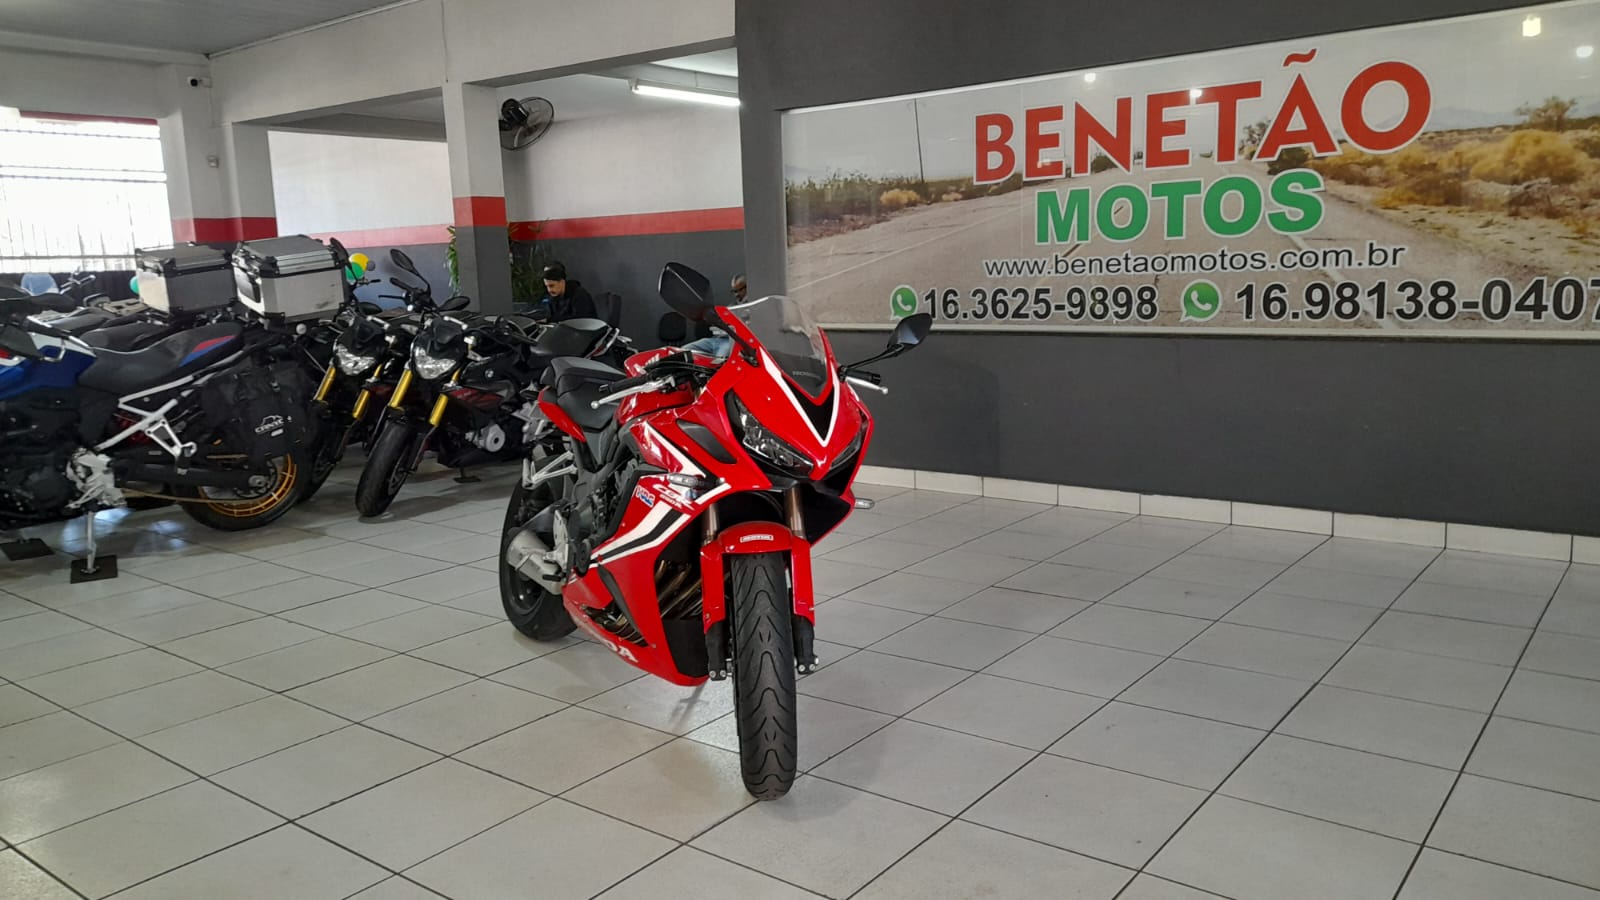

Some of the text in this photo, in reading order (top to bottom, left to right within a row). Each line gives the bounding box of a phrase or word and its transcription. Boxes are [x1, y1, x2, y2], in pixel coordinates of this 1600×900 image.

[975, 48, 1432, 183] BENETÃO
[1036, 169, 1325, 244] MOTOS
[985, 243, 1405, 276] www.benetaomotos.com.br
[924, 285, 1159, 321] 16.3625-9898
